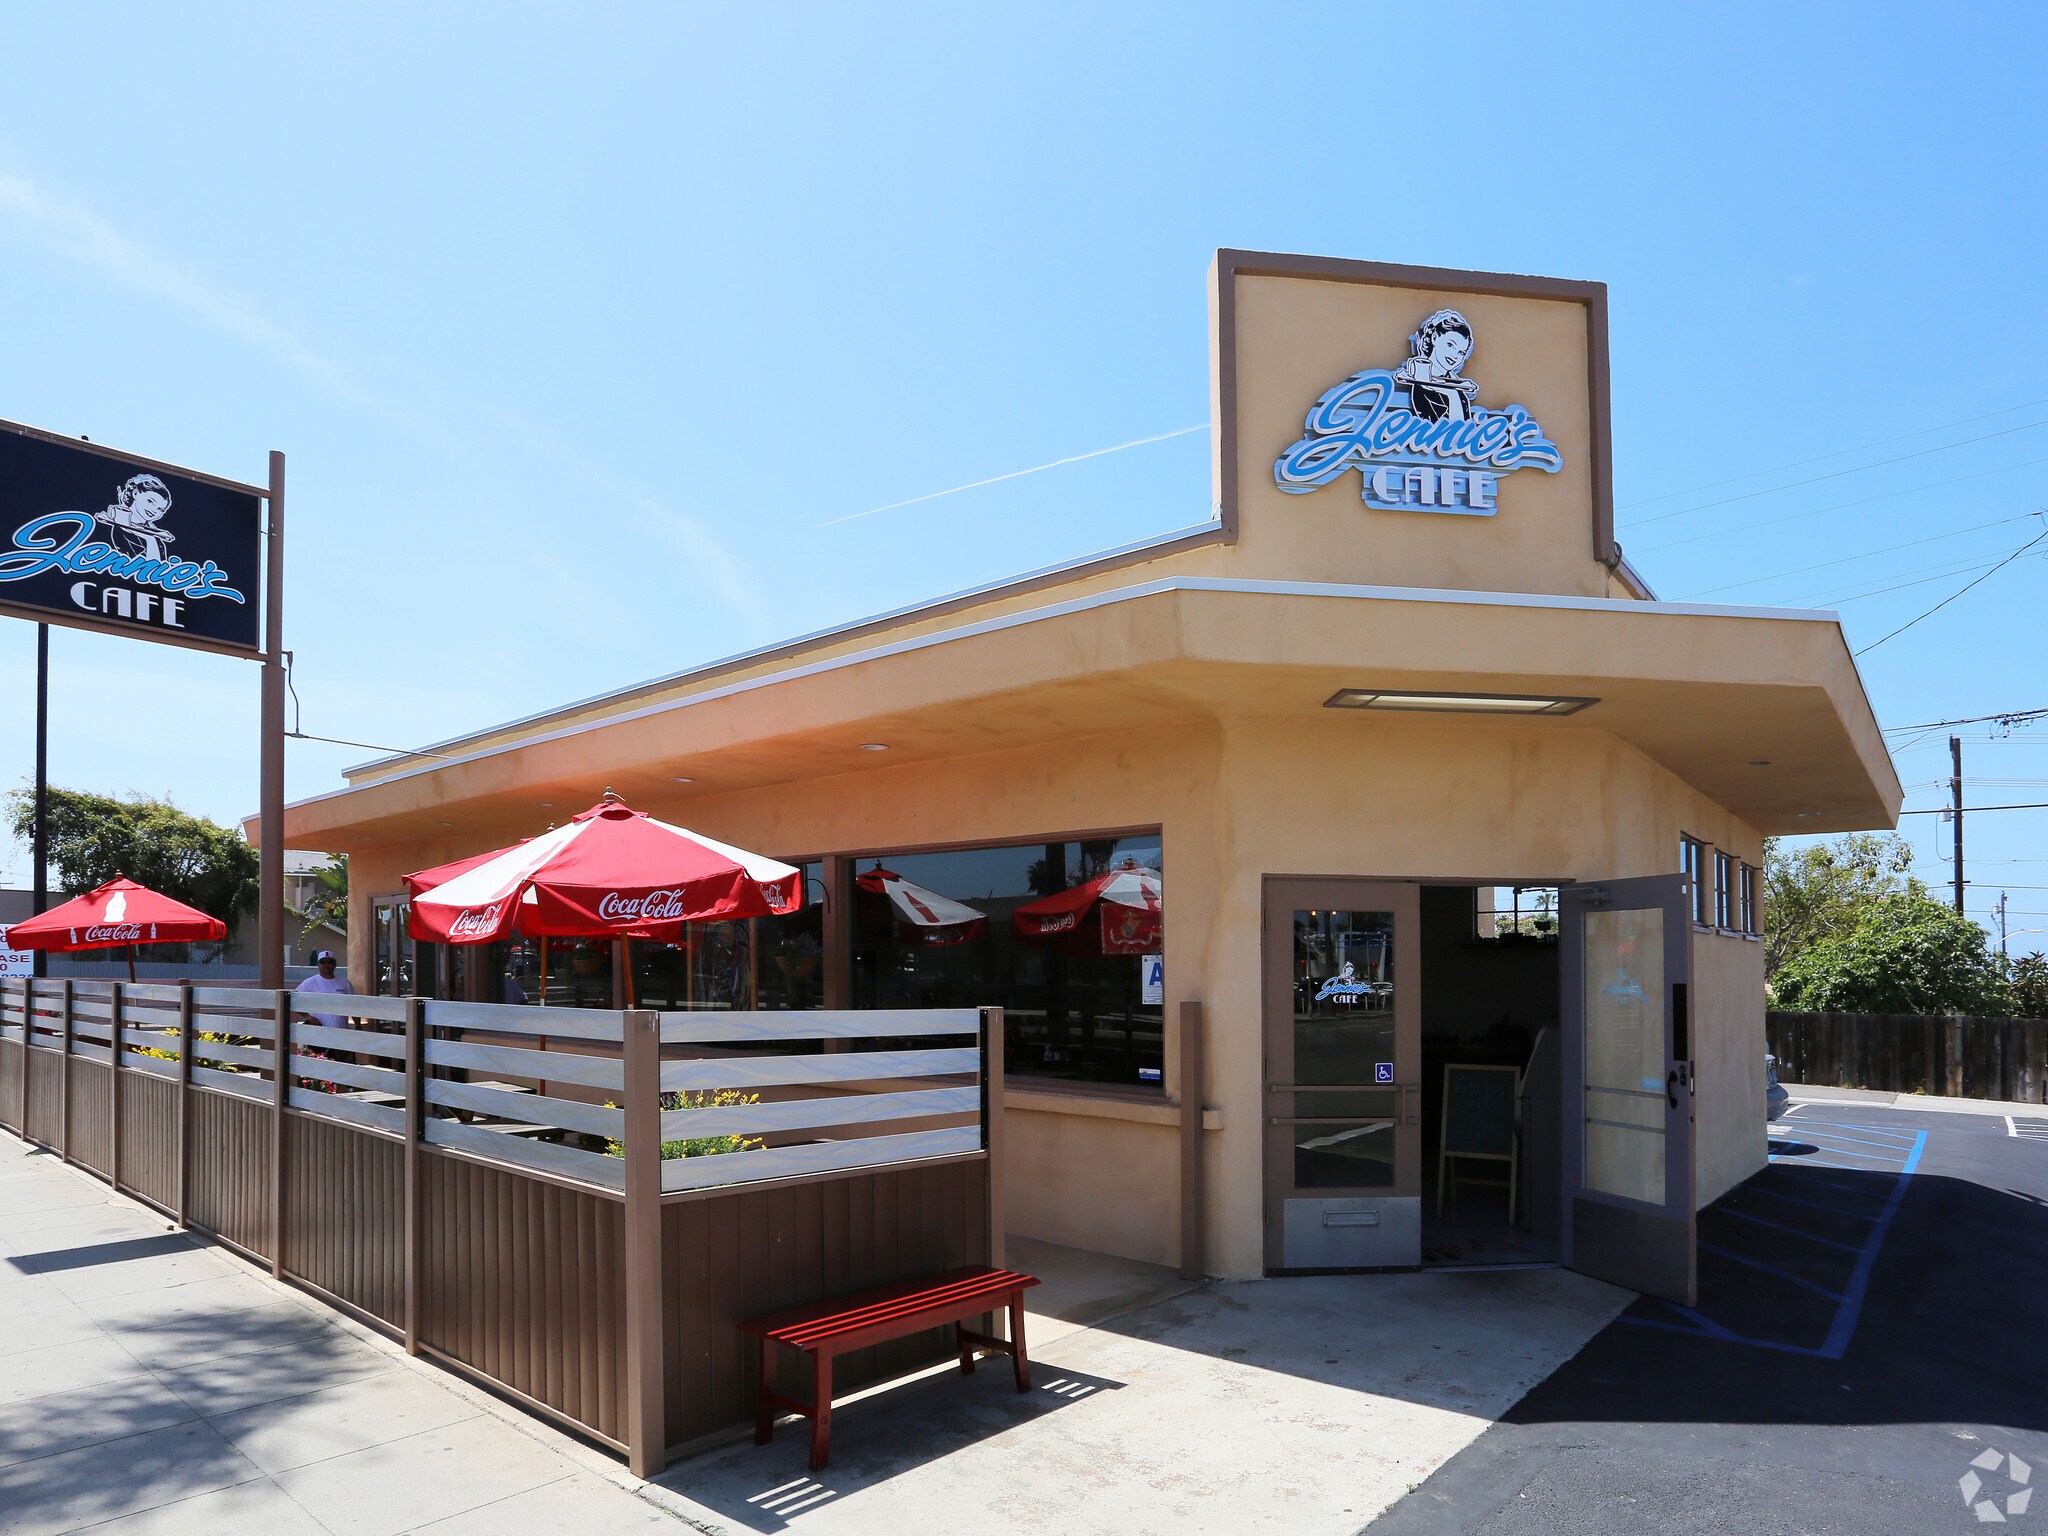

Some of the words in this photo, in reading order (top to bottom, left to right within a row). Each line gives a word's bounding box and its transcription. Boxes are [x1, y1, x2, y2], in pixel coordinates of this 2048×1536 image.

[1281, 374, 1560, 482] Jennie's
[1373, 465, 1495, 508] CAFE
[0, 510, 246, 605] Jennie's
[70, 581, 186, 629] CAFE
[449, 904, 502, 936] Coca-Cola
[598, 888, 686, 920] Coca-Cola
[85, 923, 143, 942] Coca-Cola
[1149, 963, 1163, 986] A
[1332, 994, 1358, 1004] CAFE
